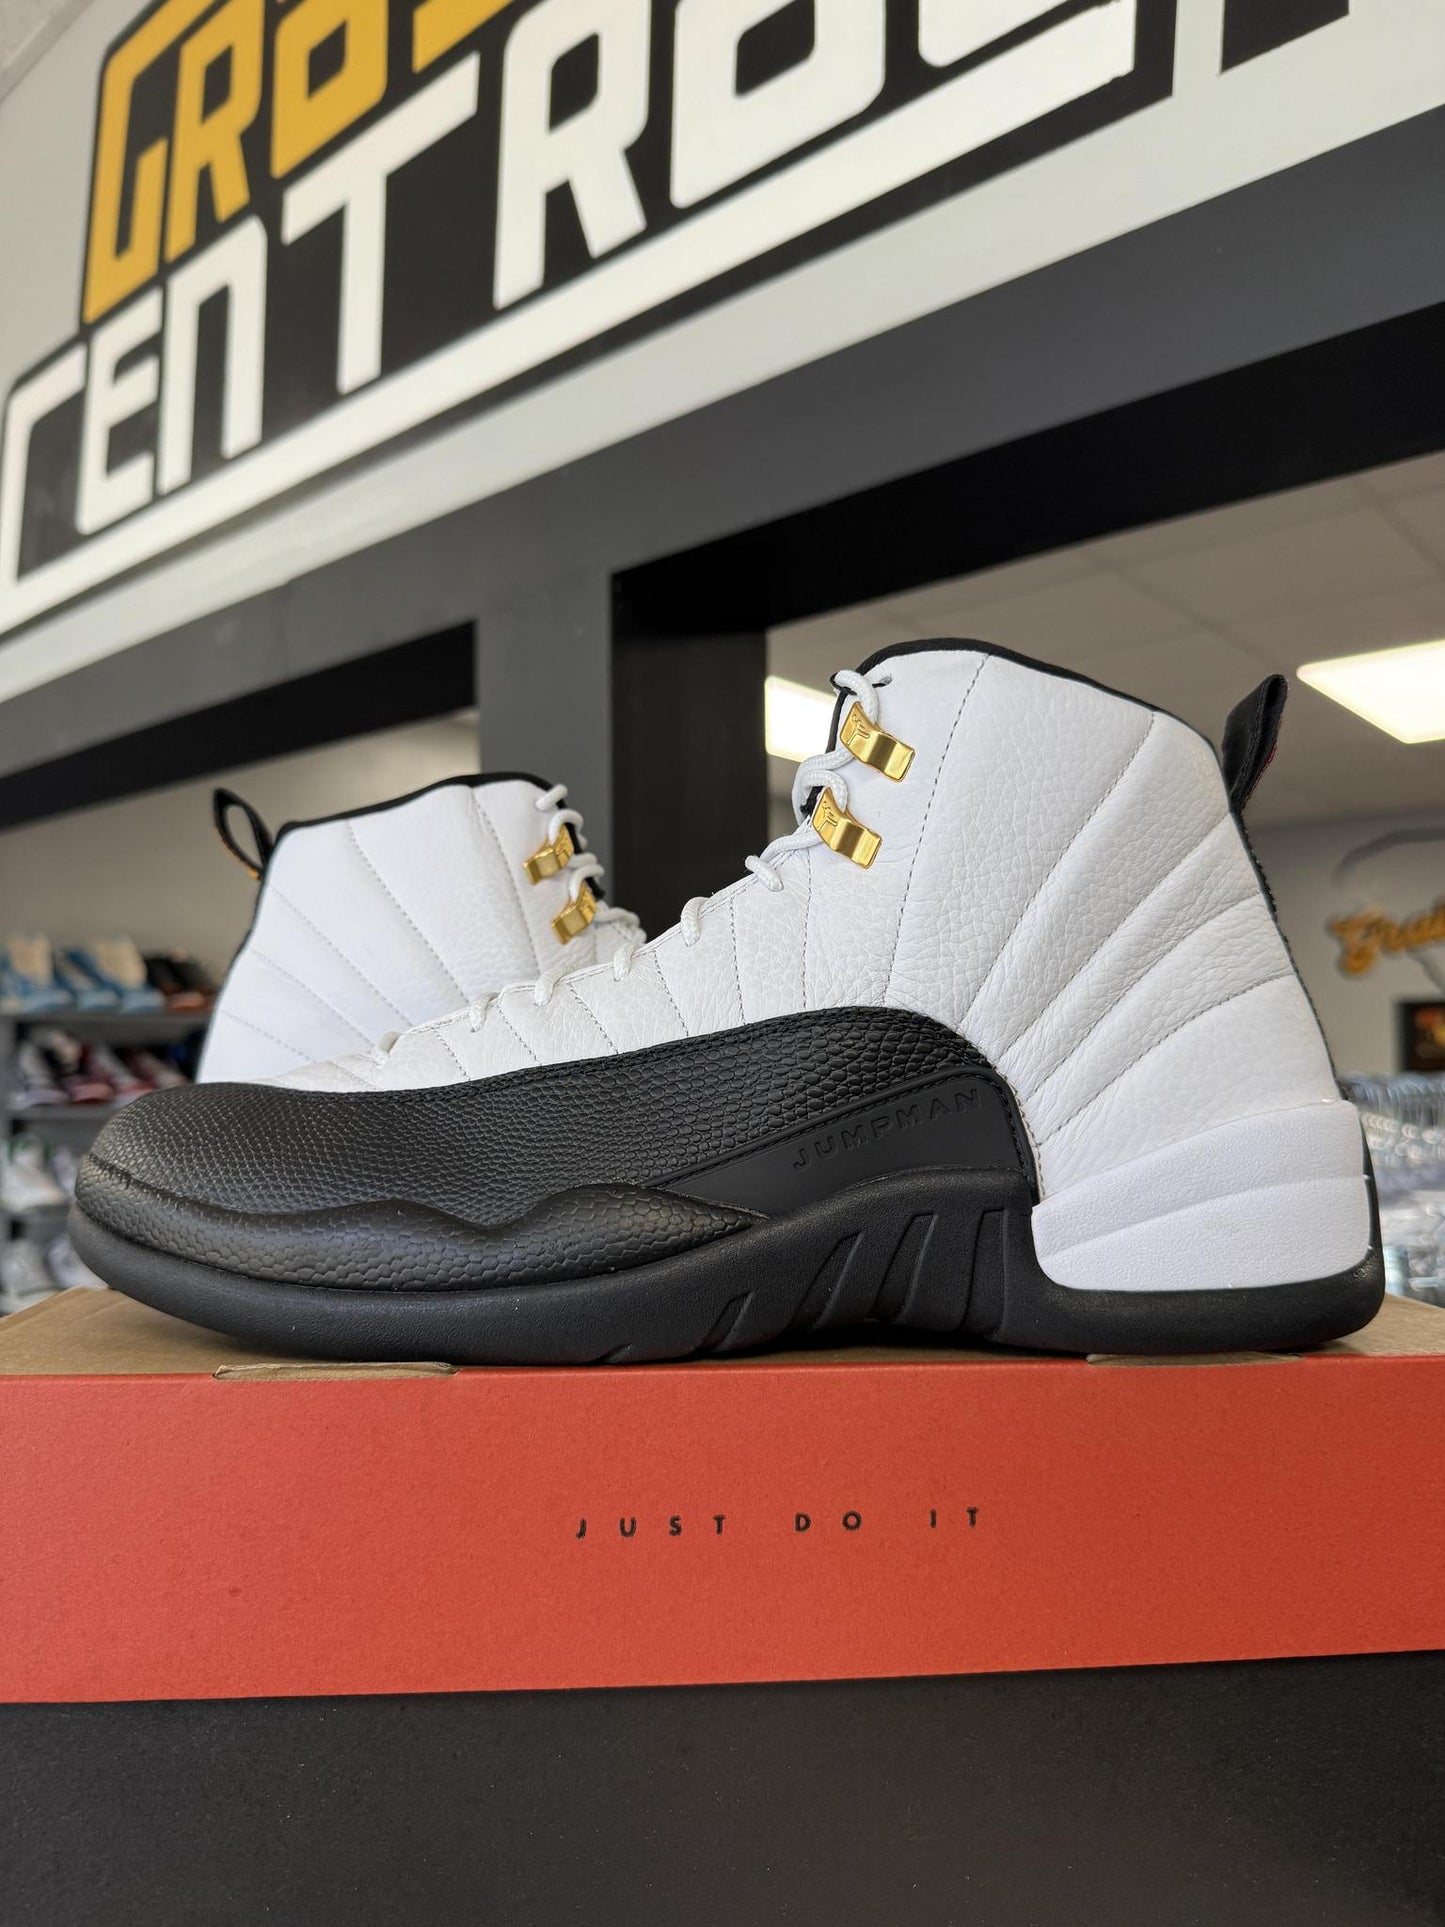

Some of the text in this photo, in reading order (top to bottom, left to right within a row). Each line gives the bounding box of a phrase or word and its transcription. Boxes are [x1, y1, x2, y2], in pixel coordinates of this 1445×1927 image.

[792, 1088, 981, 1171] JUMPMAN
[575, 1506, 980, 1539] JUST DO IT
